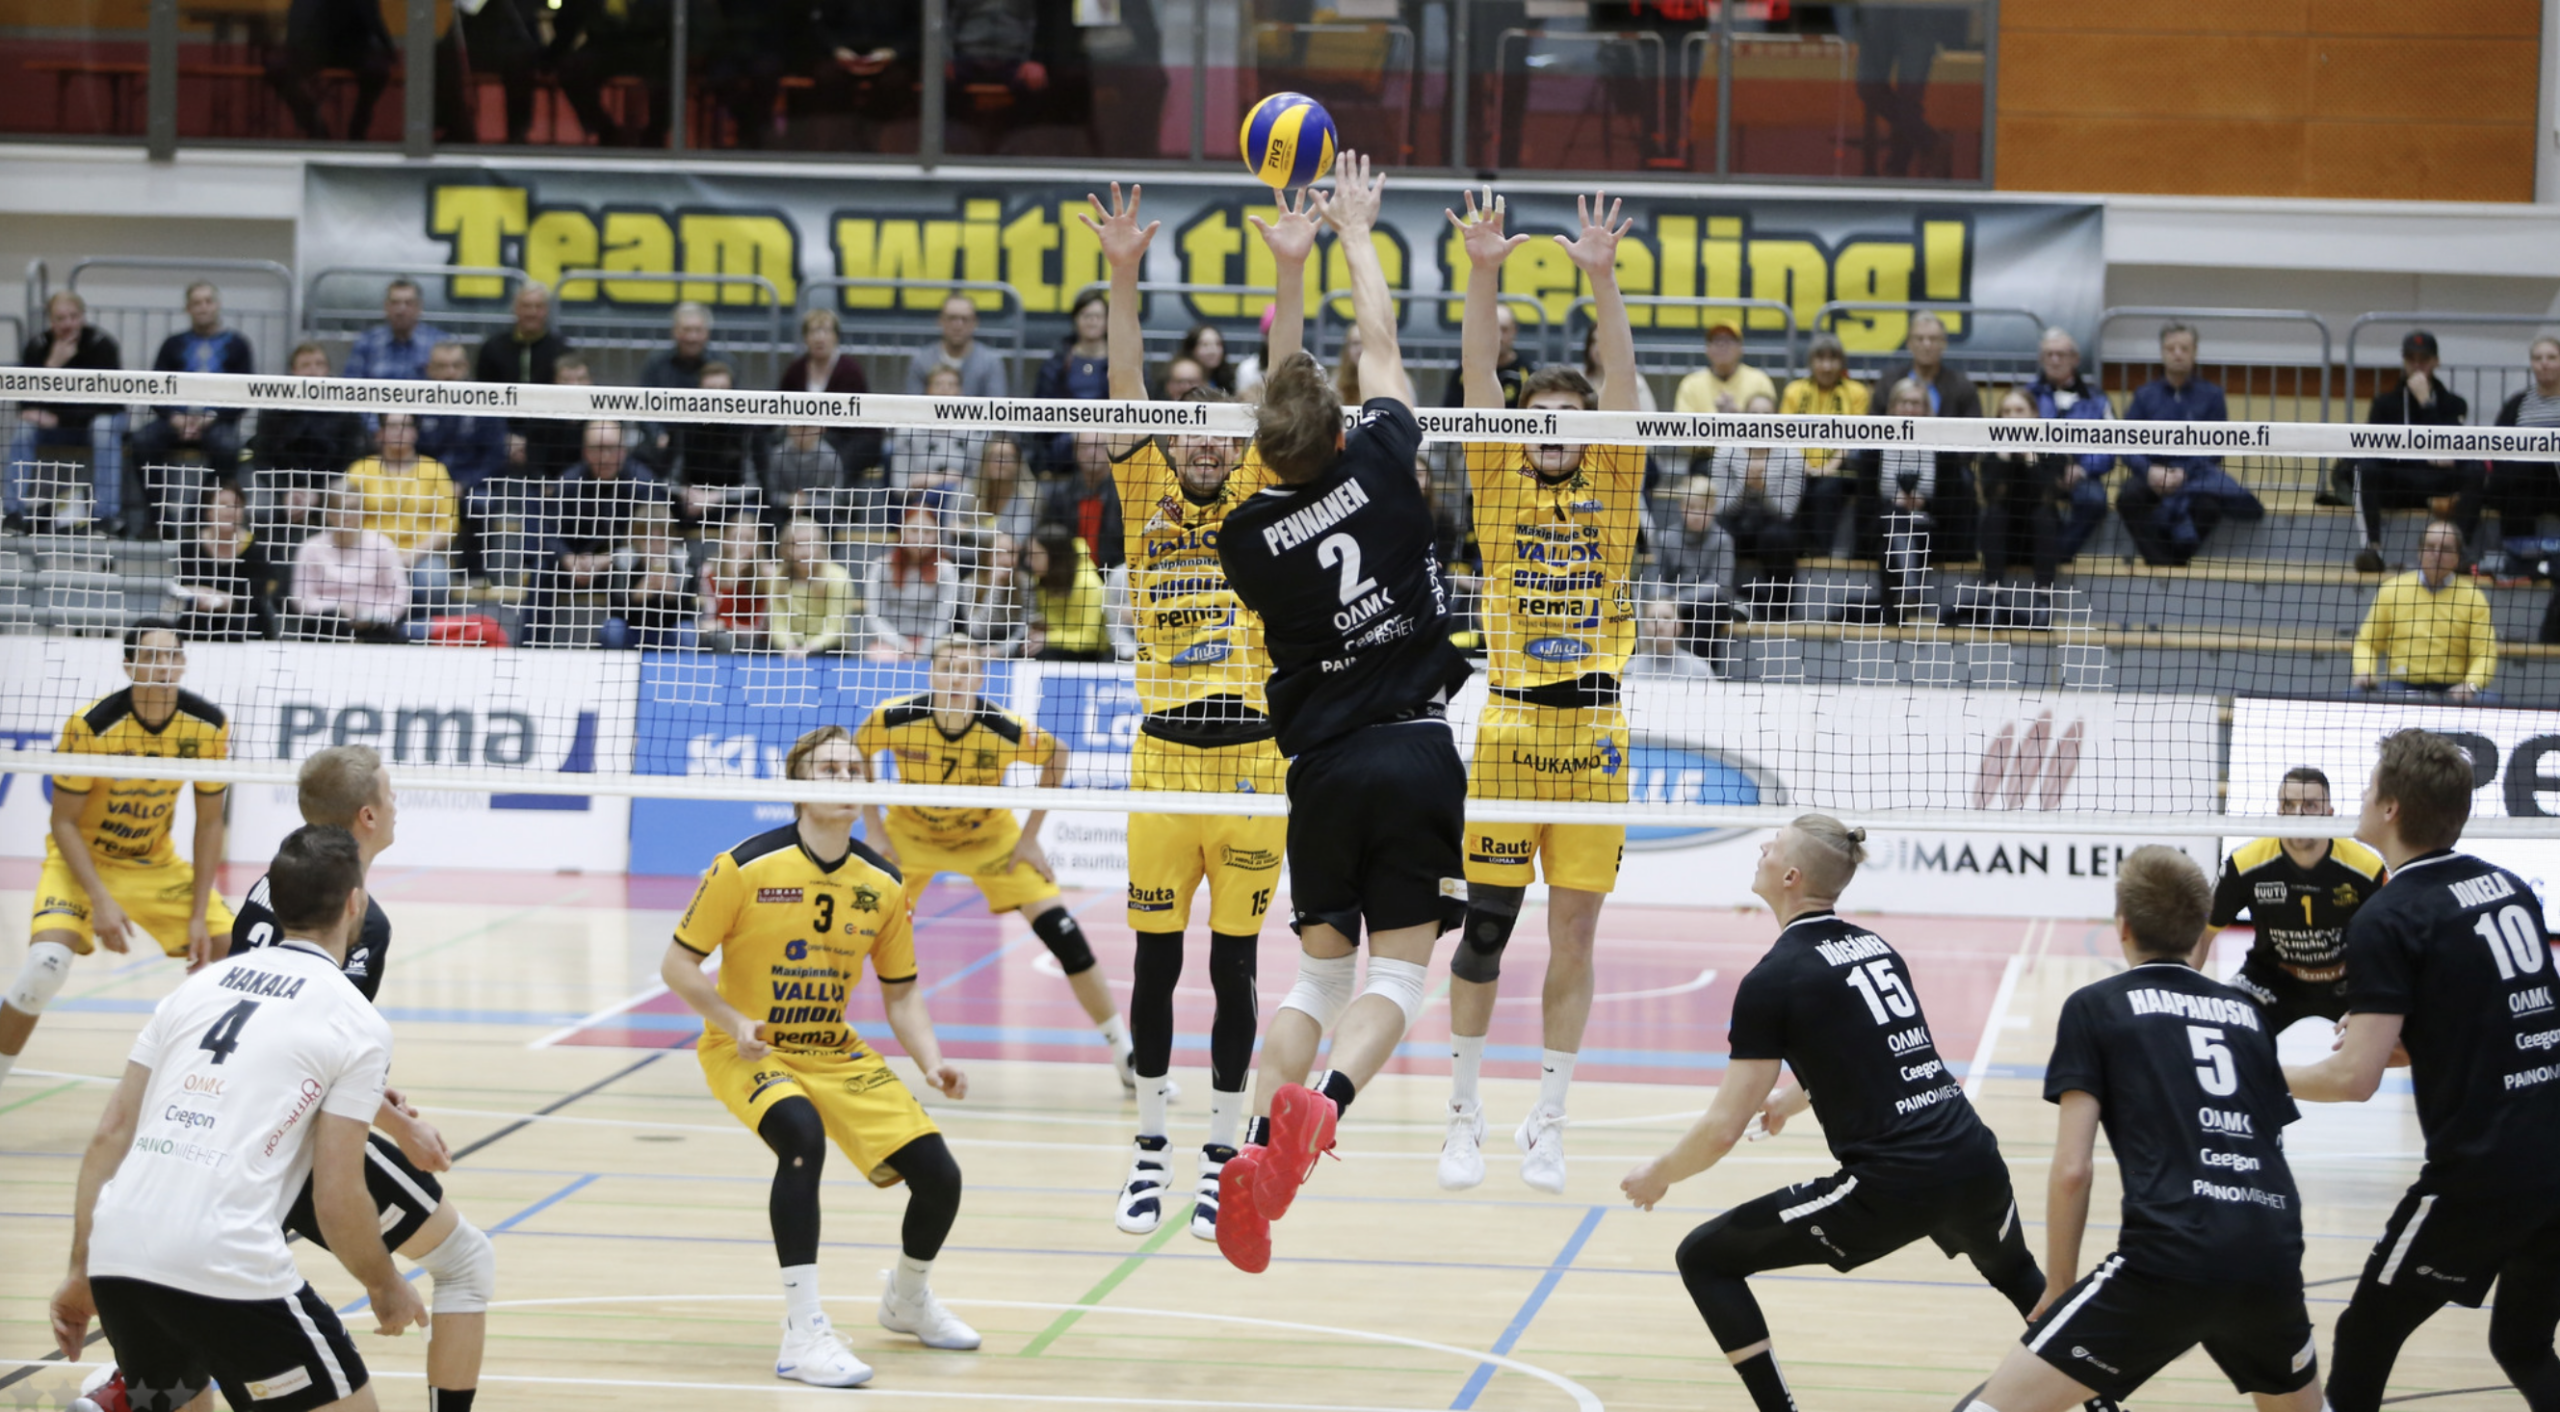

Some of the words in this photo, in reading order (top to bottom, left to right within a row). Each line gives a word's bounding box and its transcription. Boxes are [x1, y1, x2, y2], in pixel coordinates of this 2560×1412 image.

[428, 184, 799, 306] Team
[836, 197, 1143, 313] with
[248, 379, 518, 406] www.loimaanseurahuone.fi
[590, 390, 861, 417] www.loimaanseurahuone.fi
[934, 400, 1208, 426] www.loimaanseurahuone.fi
[1636, 417, 1914, 442] www.loimaanseurahuone.fi
[1988, 422, 2270, 447] www.loimaanseurahuone.fi
[1262, 477, 1370, 557] PENNANEN
[1316, 532, 1378, 606] 2
[1512, 750, 1602, 774] LAUKAMO
[1862, 840, 2049, 875] OIMAAN
[813, 893, 835, 934] 3
[1251, 888, 1271, 917] 15
[2300, 894, 2313, 927] 1
[2473, 904, 2544, 980] 10
[218, 966, 306, 1000] HAKALA
[1845, 958, 1917, 1026] 15
[2126, 989, 2260, 1032] HAAPAKOSKI
[200, 999, 261, 1065] 4
[1900, 1059, 1943, 1082] Ceegon
[2186, 1025, 2238, 1097] 5
[2200, 1147, 2260, 1171] Ceegon
[2192, 1179, 2287, 1210] PAINOMIEHET
